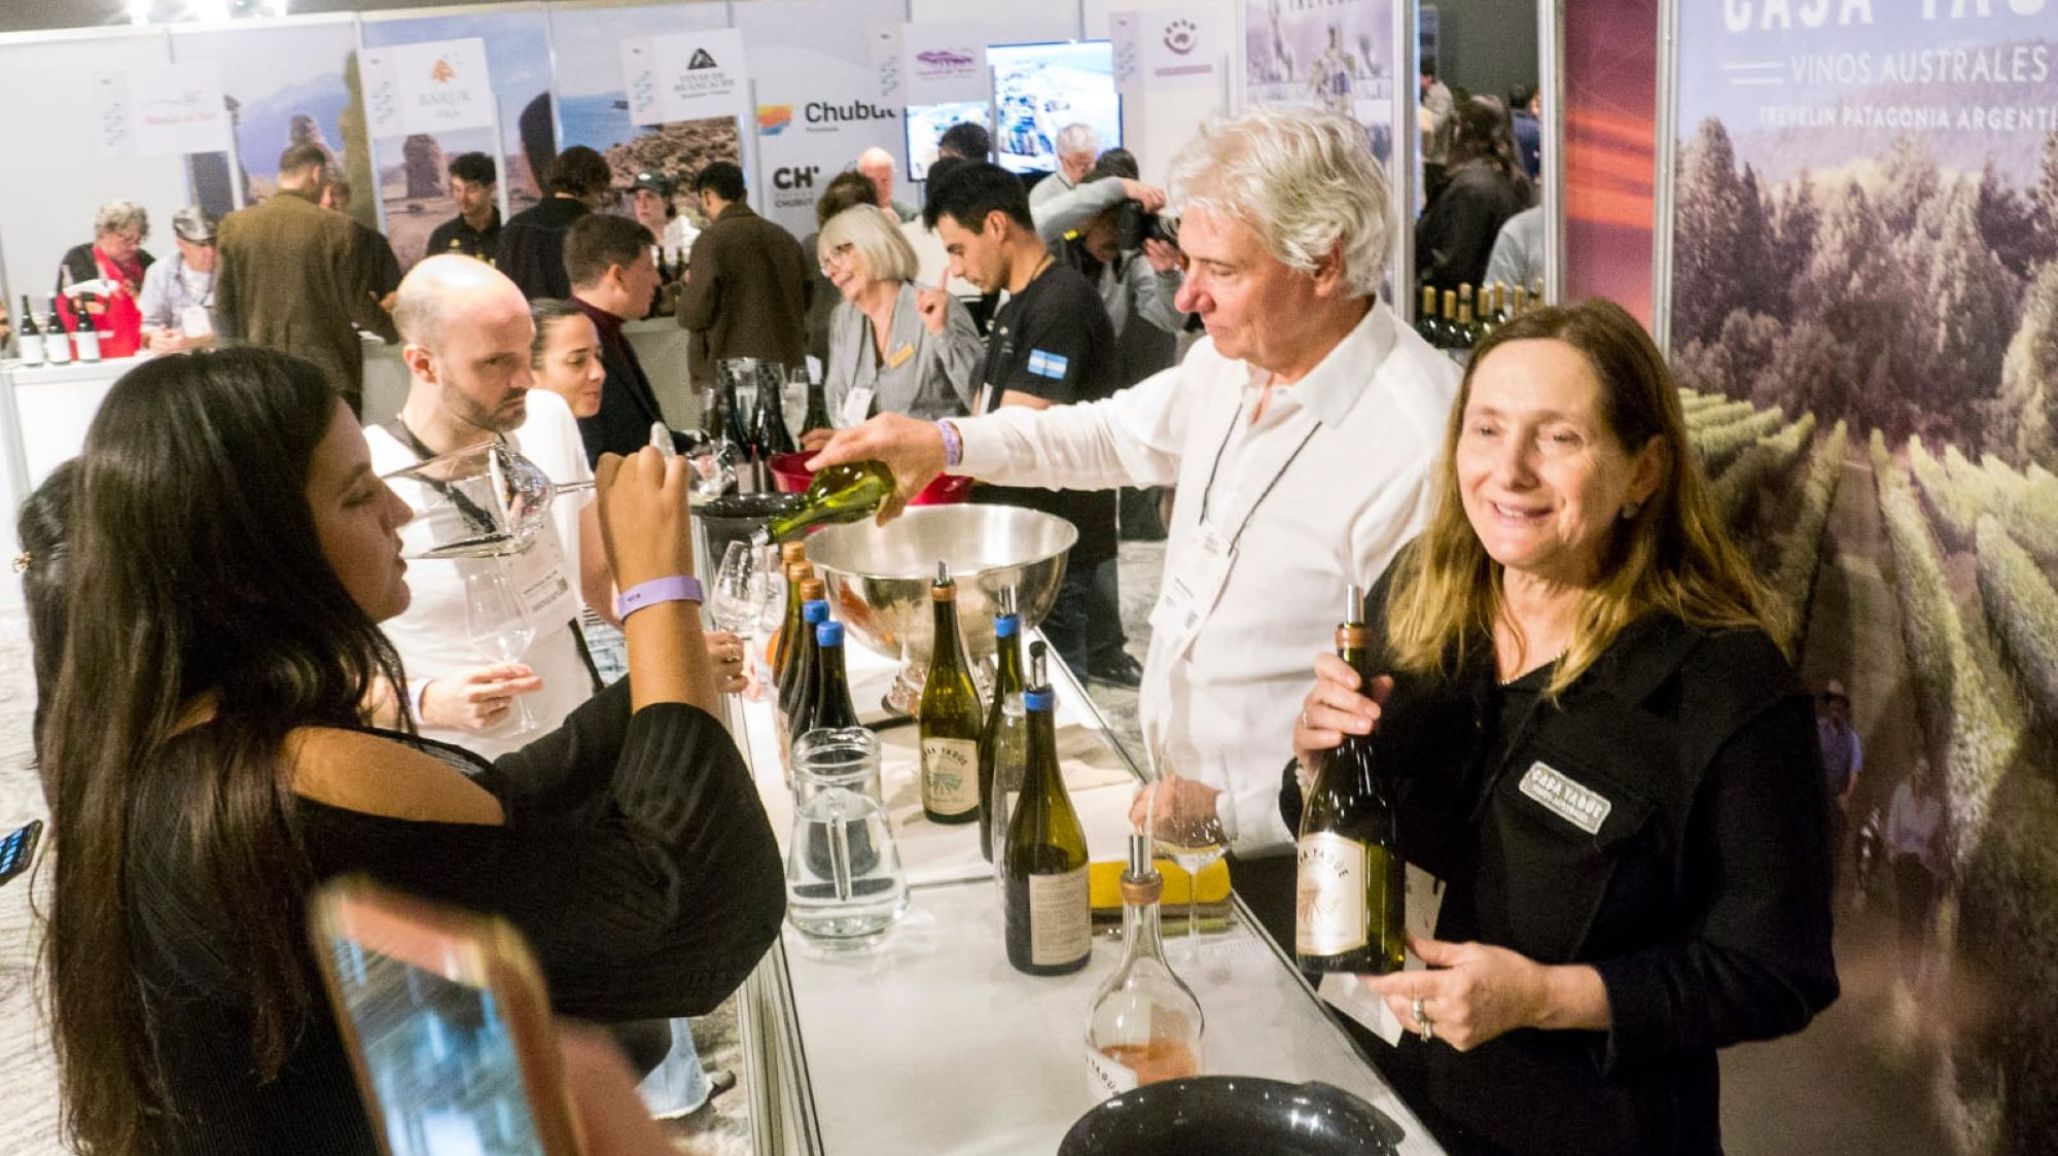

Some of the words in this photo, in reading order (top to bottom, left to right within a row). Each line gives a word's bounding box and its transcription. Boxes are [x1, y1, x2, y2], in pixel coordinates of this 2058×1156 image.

[1790, 52, 1871, 84] VINOS
[1880, 45, 2049, 84] AUSTRALES
[1758, 105, 1837, 128] TREVELIN
[1842, 105, 1949, 129] PATAGONIA
